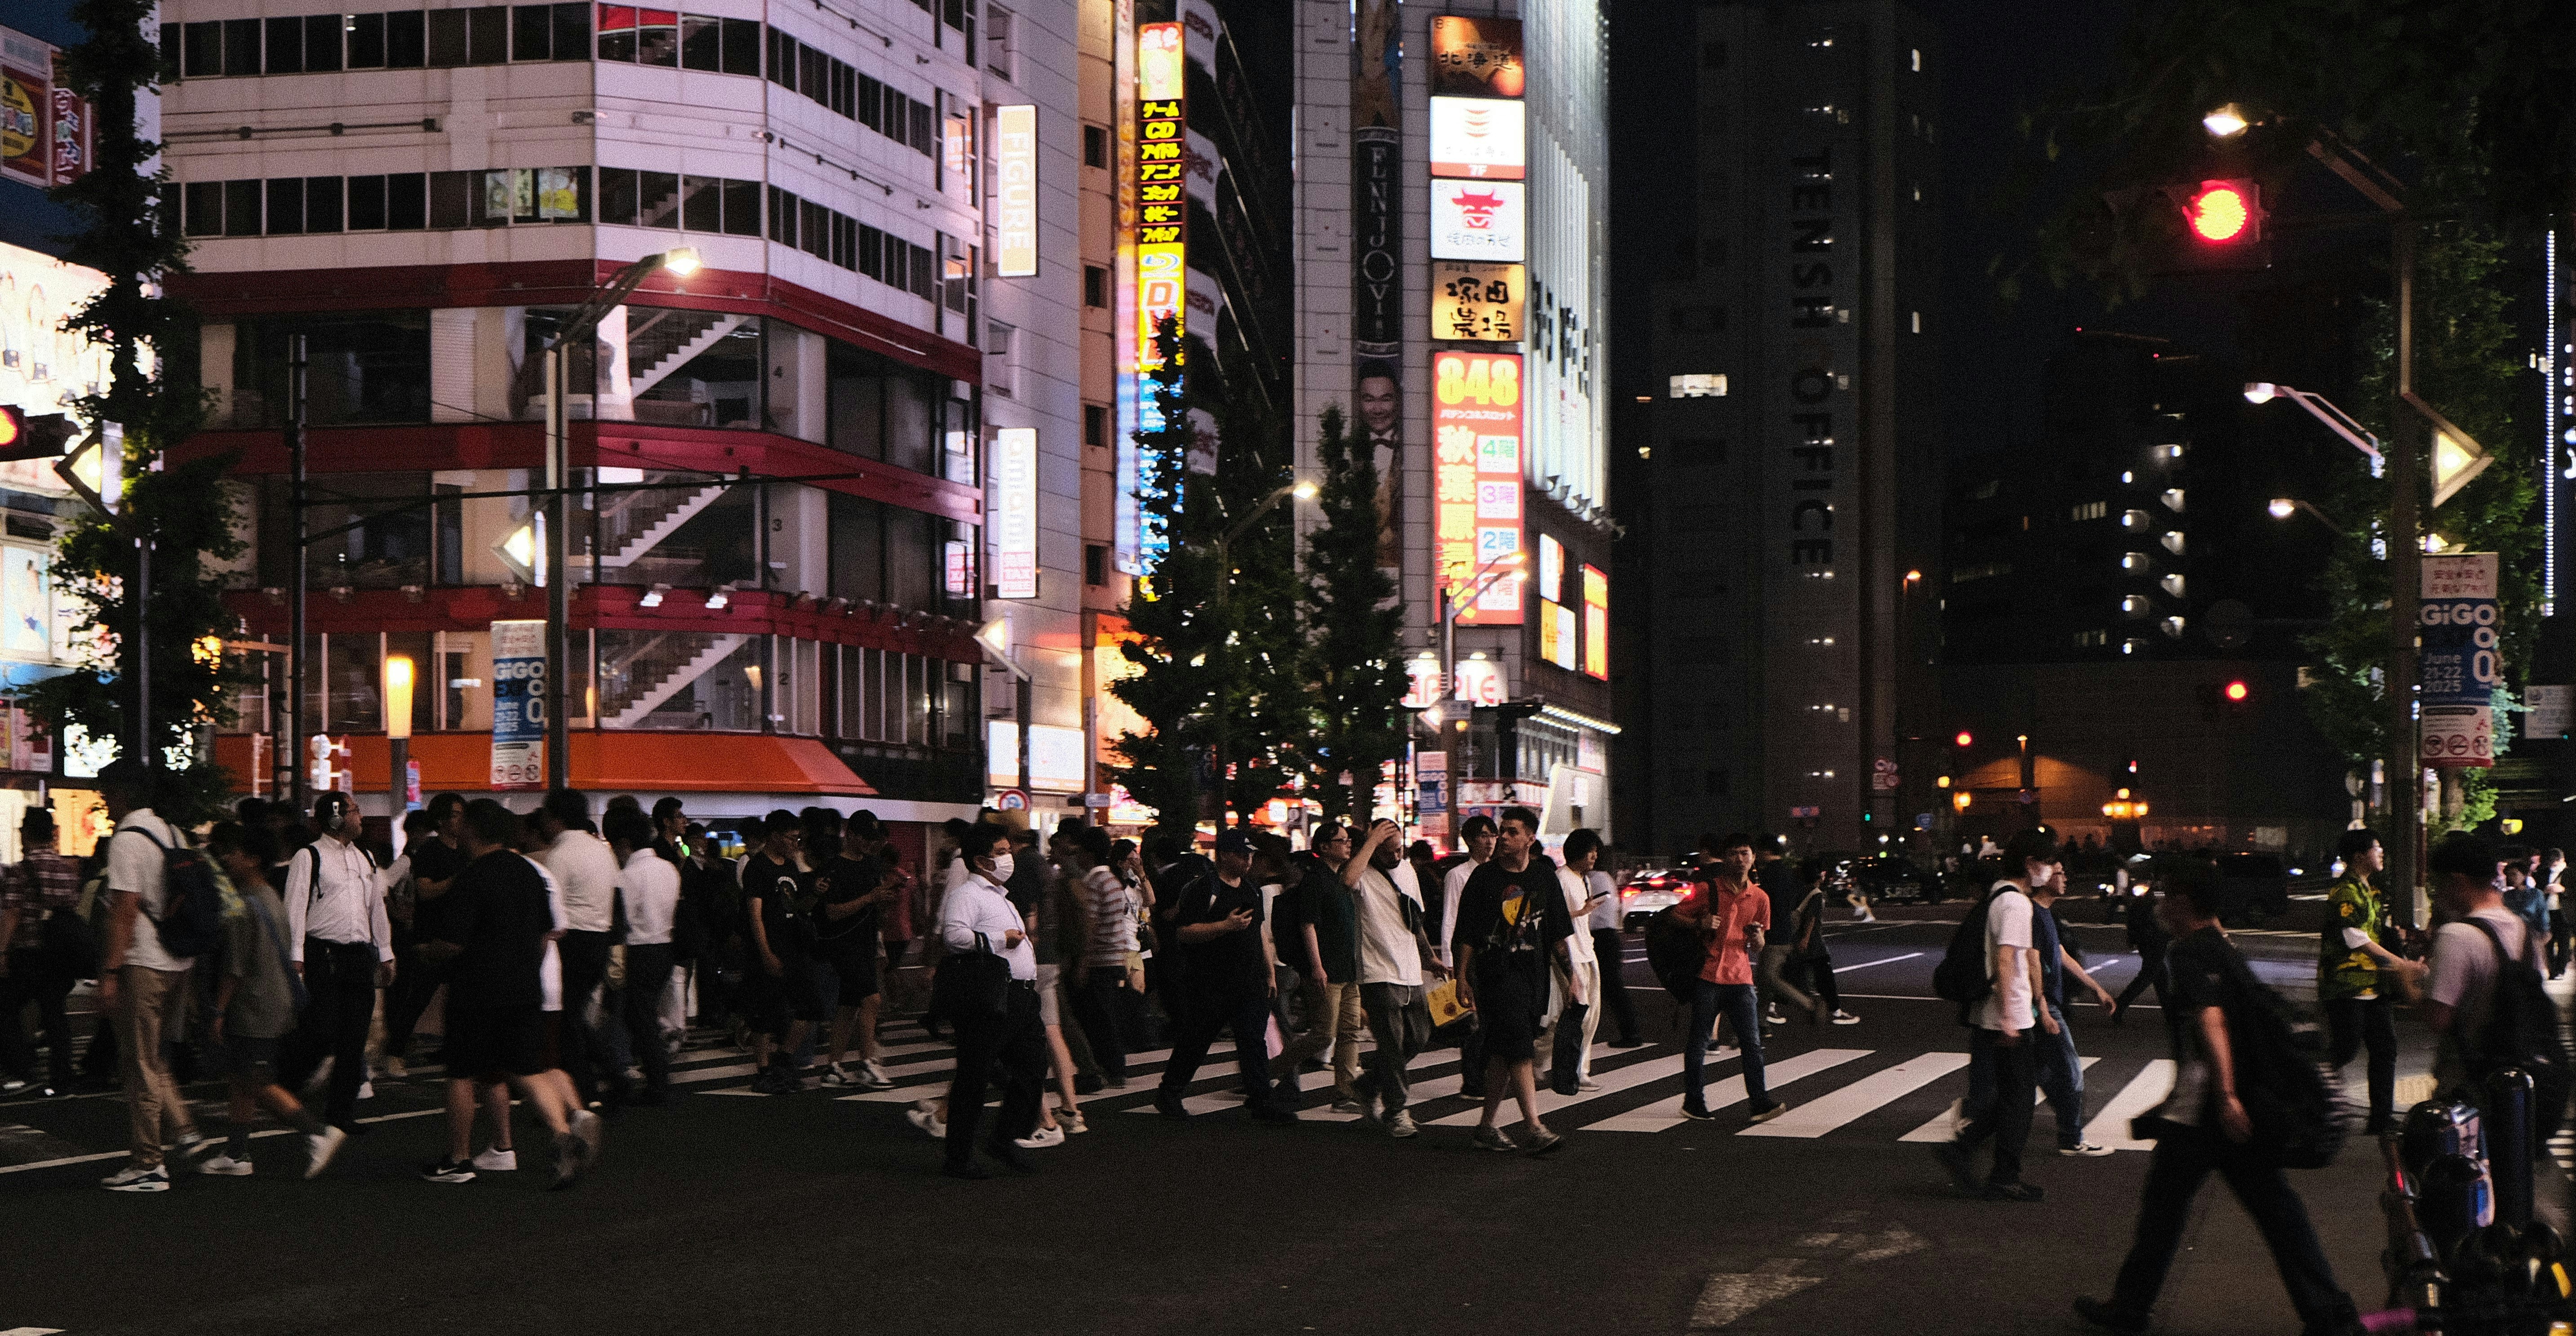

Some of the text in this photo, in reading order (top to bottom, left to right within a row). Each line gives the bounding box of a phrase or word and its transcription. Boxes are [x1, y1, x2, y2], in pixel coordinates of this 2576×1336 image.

[1145, 121, 1176, 139] CD
[1141, 164, 1181, 180] アニメ
[1003, 132, 1030, 249] FIGURE
[1438, 357, 1519, 406] 848
[1482, 439, 1515, 458] 4階
[1791, 369, 1833, 565] OFFICE
[1482, 485, 1515, 504] 3階
[772, 518, 783, 532] 3
[1483, 530, 1516, 549] 2階
[2421, 603, 2497, 625] GiGO
[2424, 653, 2462, 664] June
[494, 661, 545, 679] GiGO
[778, 672, 789, 686] 2
[2424, 680, 2462, 693] 2025
